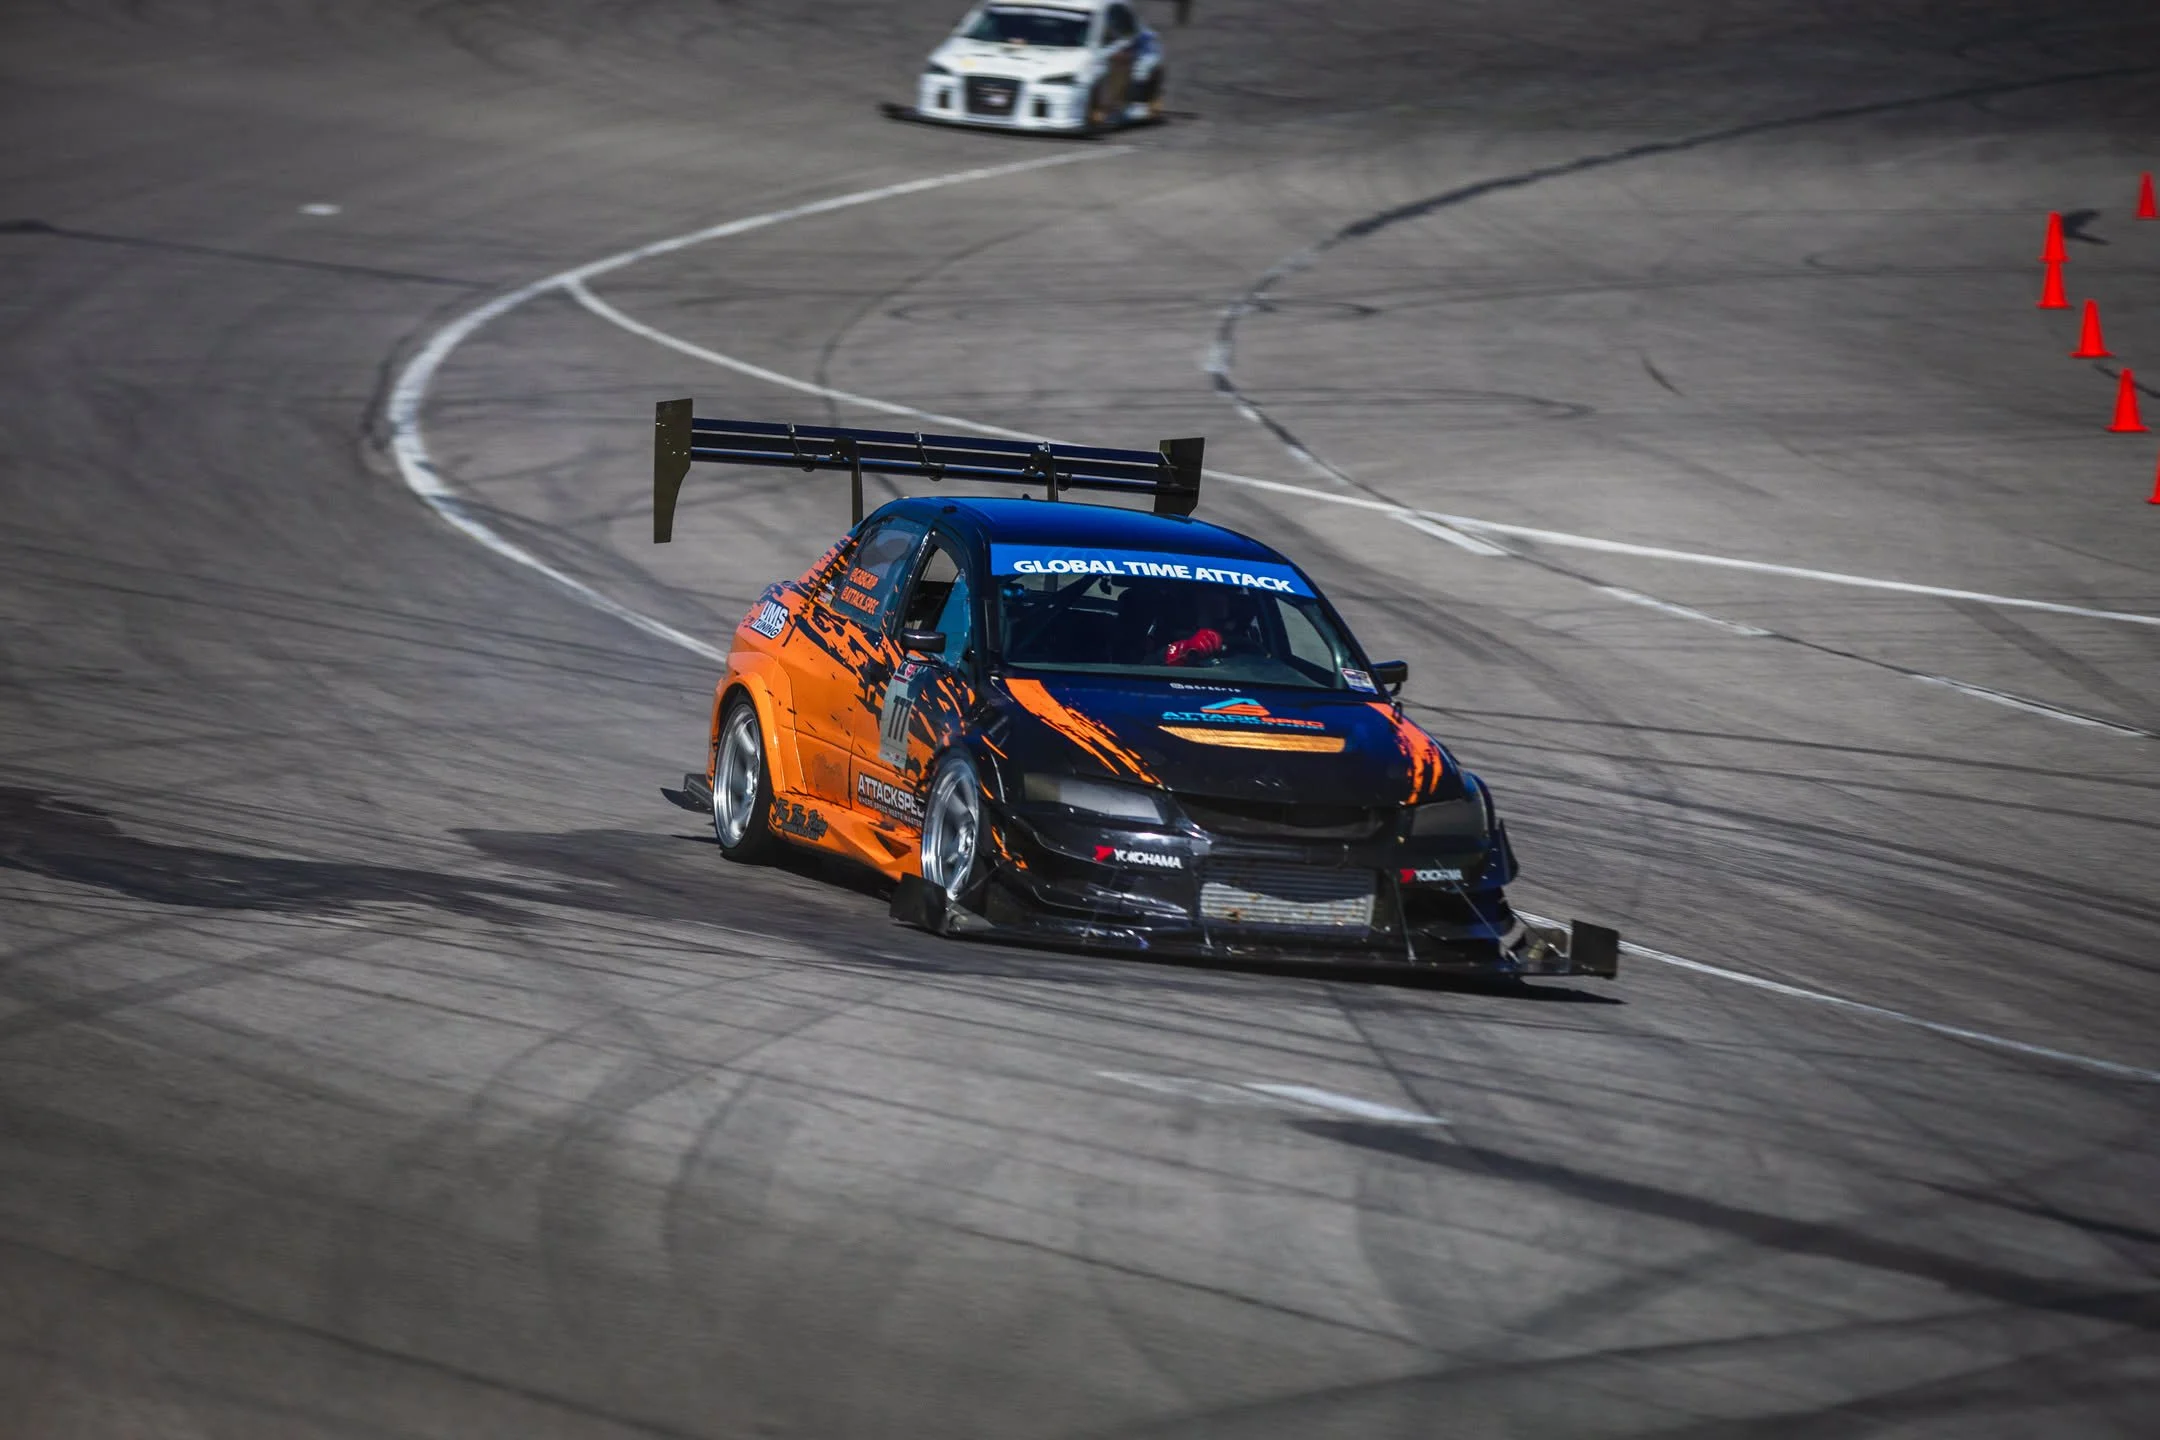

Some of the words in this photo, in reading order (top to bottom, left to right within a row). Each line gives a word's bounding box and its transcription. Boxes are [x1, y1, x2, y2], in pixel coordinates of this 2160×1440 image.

[1013, 559, 1125, 576] GLOBAL
[1123, 561, 1192, 579] TIME
[1195, 567, 1295, 593] ATTACK
[760, 600, 788, 629] UMS
[753, 618, 779, 637] TUNING
[1113, 848, 1184, 869] YOKOHAMA
